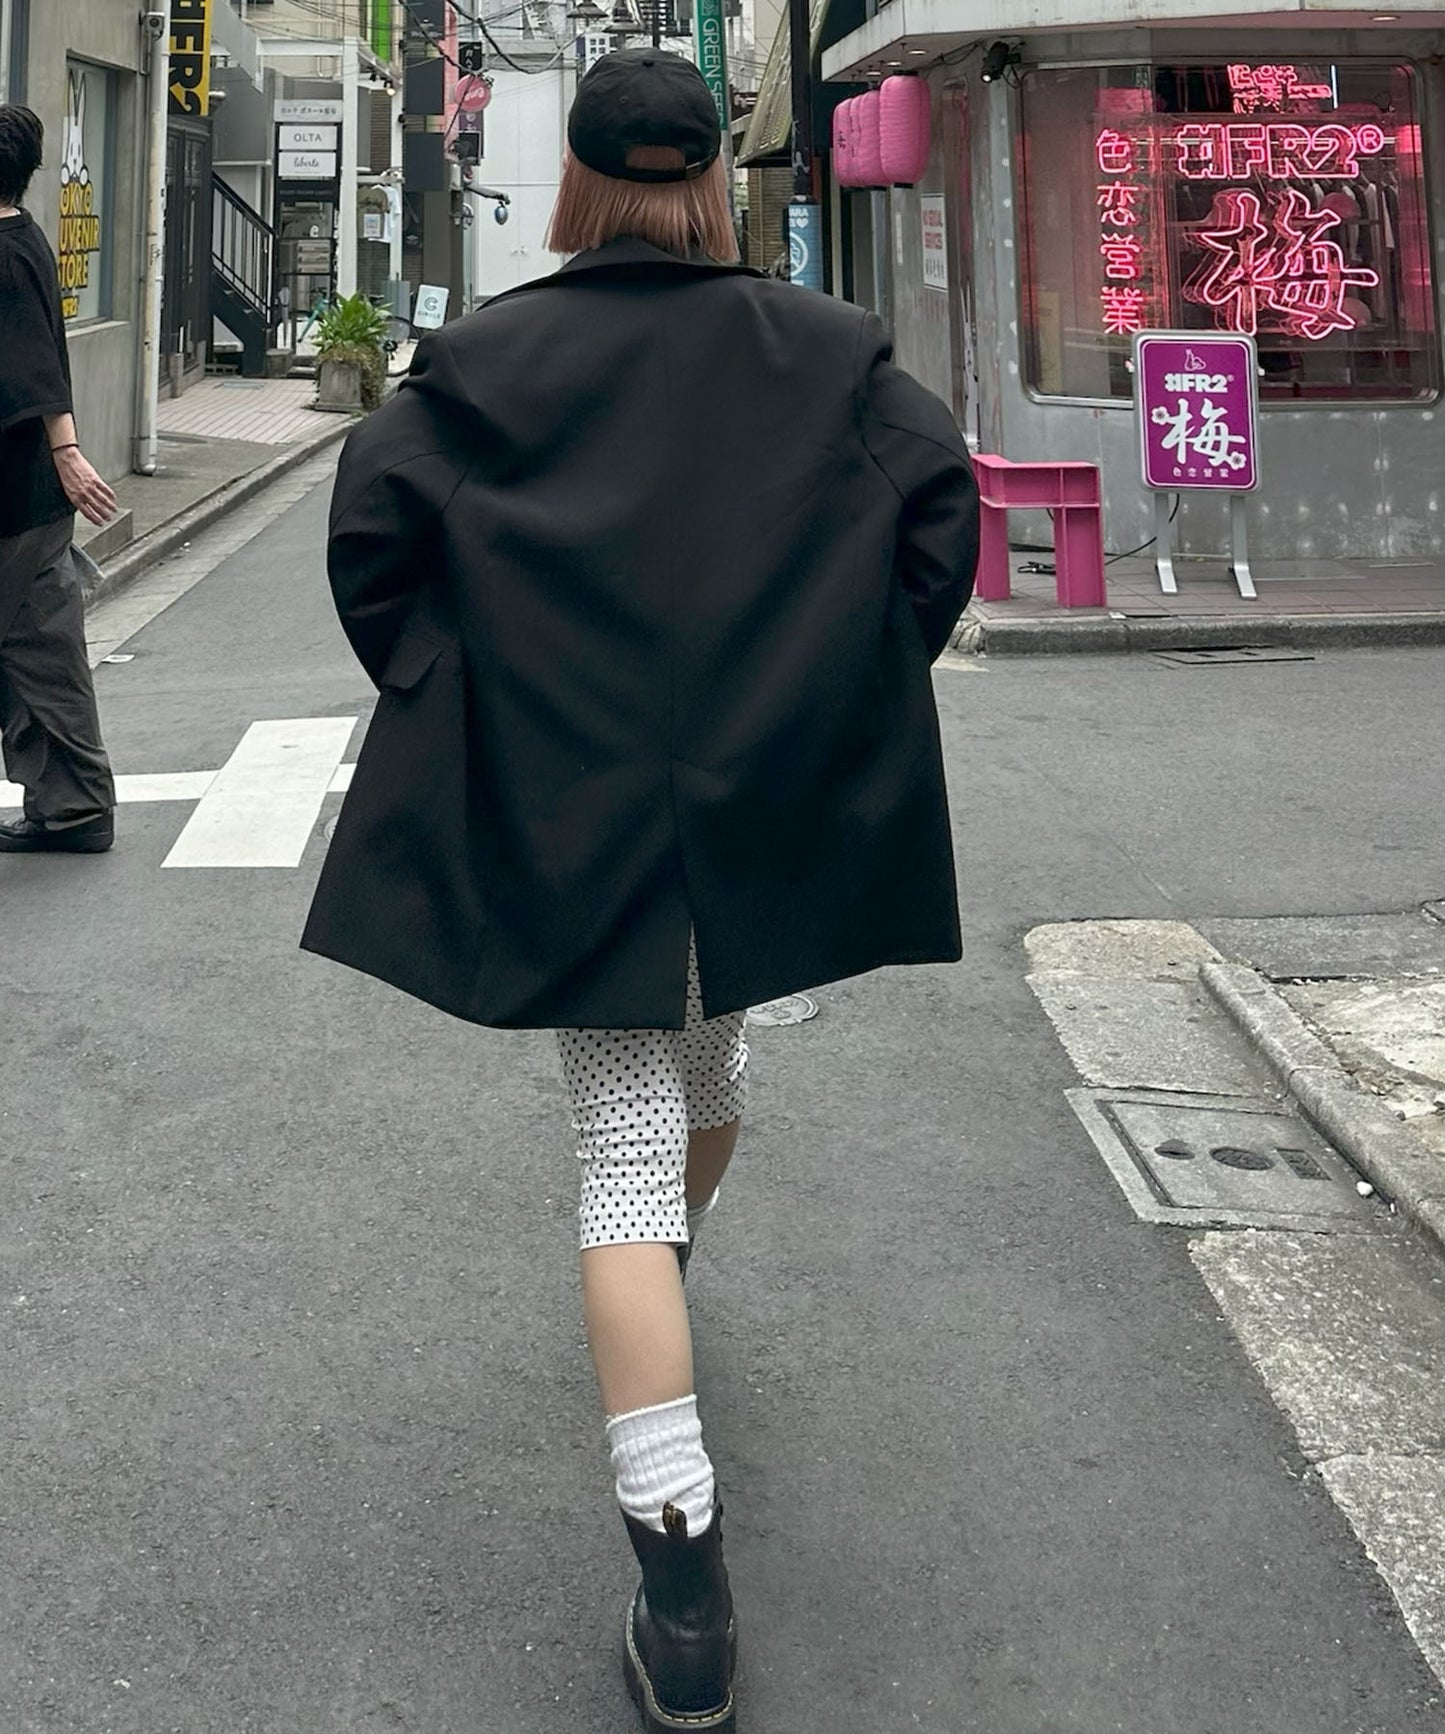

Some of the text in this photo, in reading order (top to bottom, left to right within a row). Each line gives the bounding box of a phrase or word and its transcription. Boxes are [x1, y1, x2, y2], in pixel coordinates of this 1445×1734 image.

[702, 18, 724, 124] GREEN SEE
[293, 132, 322, 143] OLTA
[1096, 129, 1143, 334] 色恋営業
[1160, 397, 1247, 467] 梅
